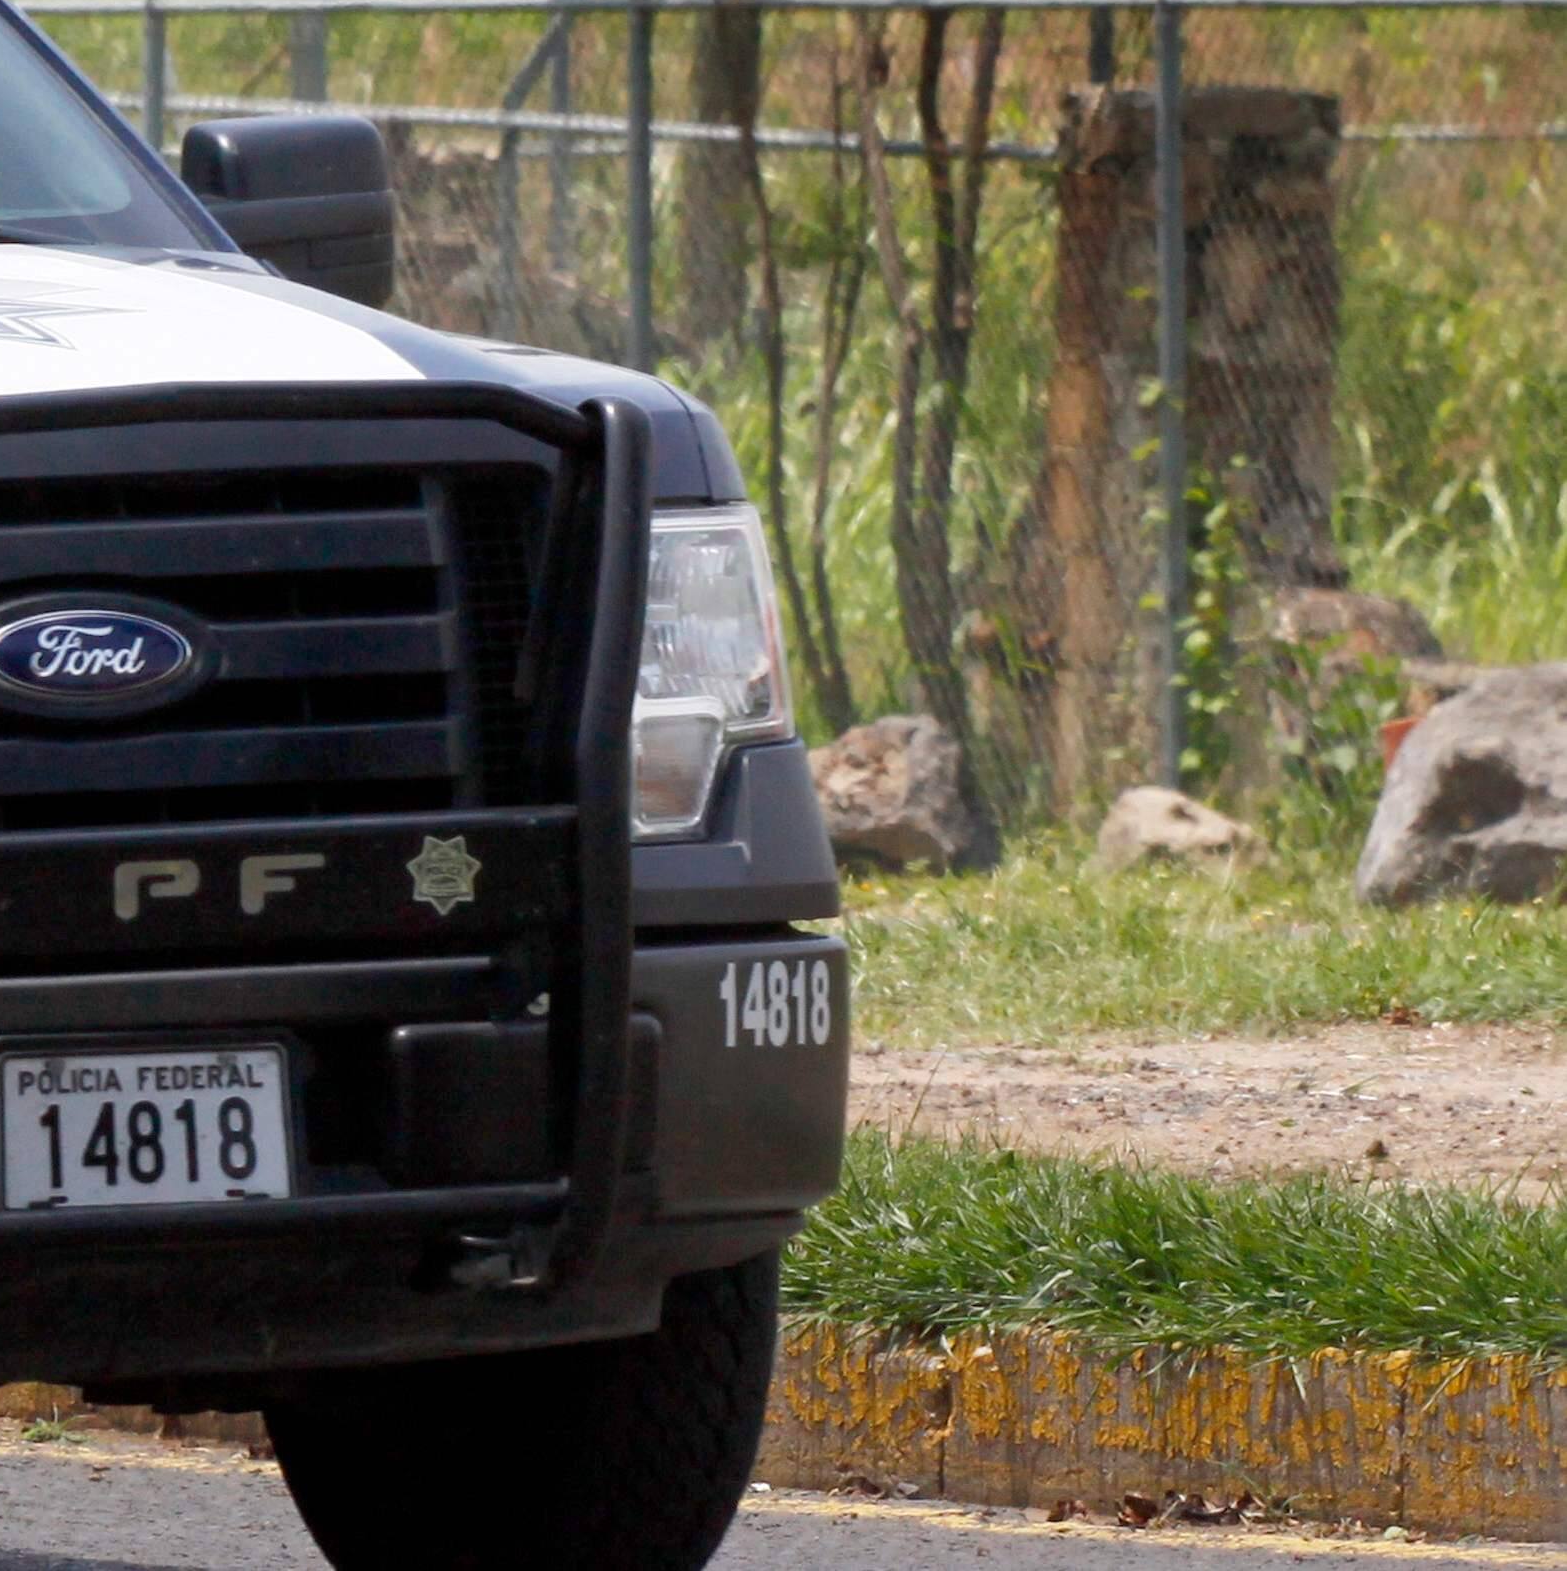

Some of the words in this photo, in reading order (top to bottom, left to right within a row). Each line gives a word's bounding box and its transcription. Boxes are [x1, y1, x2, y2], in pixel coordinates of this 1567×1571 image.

[29, 625, 146, 677] Ford
[719, 959, 830, 1048] 14818
[18, 1068, 122, 1095] POLICIA
[137, 1064, 264, 1091] FEDERAL
[40, 1096, 257, 1189] 14818
